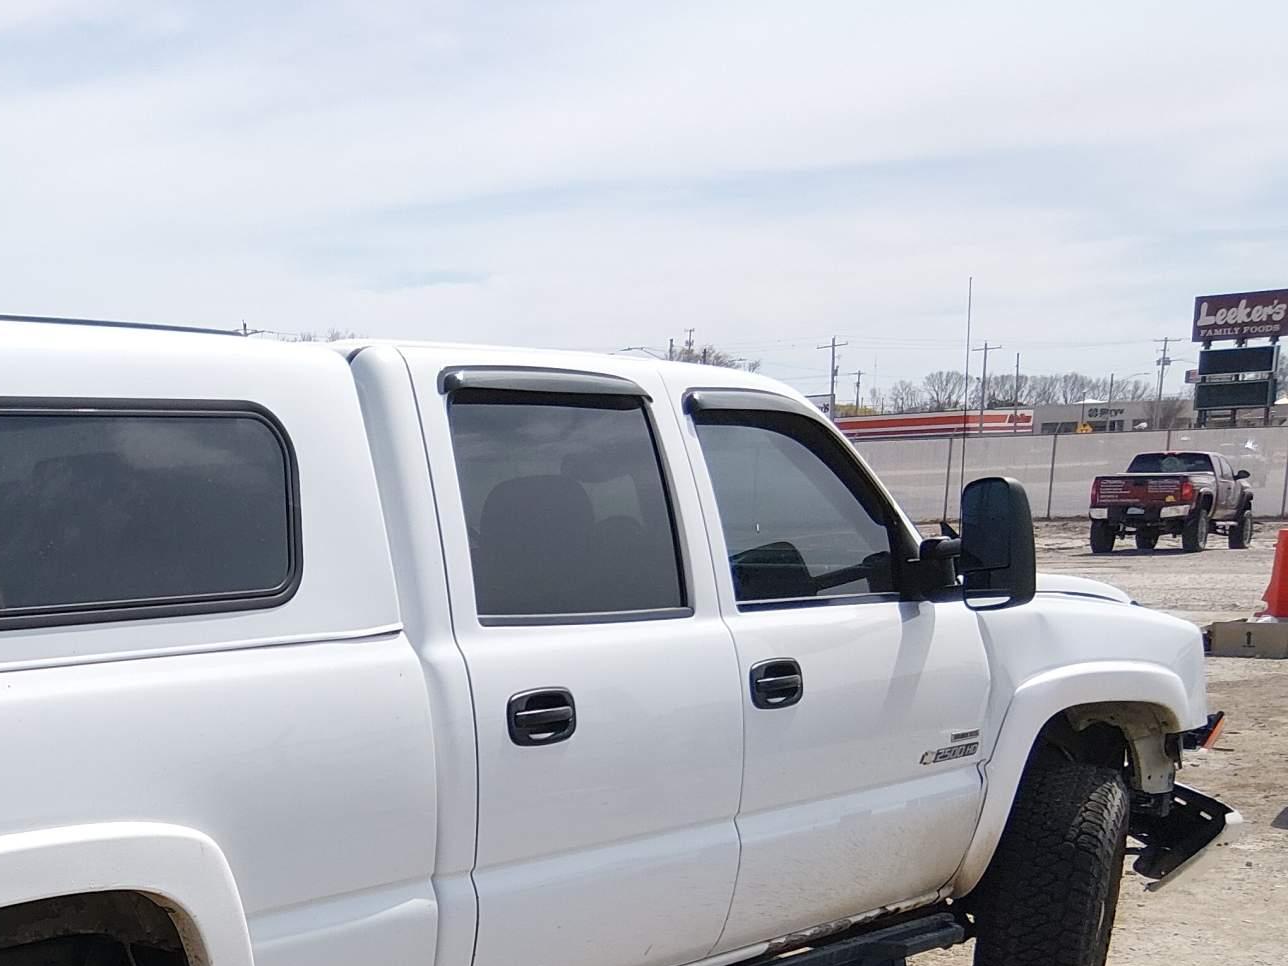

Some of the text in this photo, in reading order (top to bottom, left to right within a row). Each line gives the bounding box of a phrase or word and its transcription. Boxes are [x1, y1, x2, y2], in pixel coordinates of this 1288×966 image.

[1197, 299, 1287, 326] Leeker's
[1199, 324, 1280, 336] FAMILY FOODS
